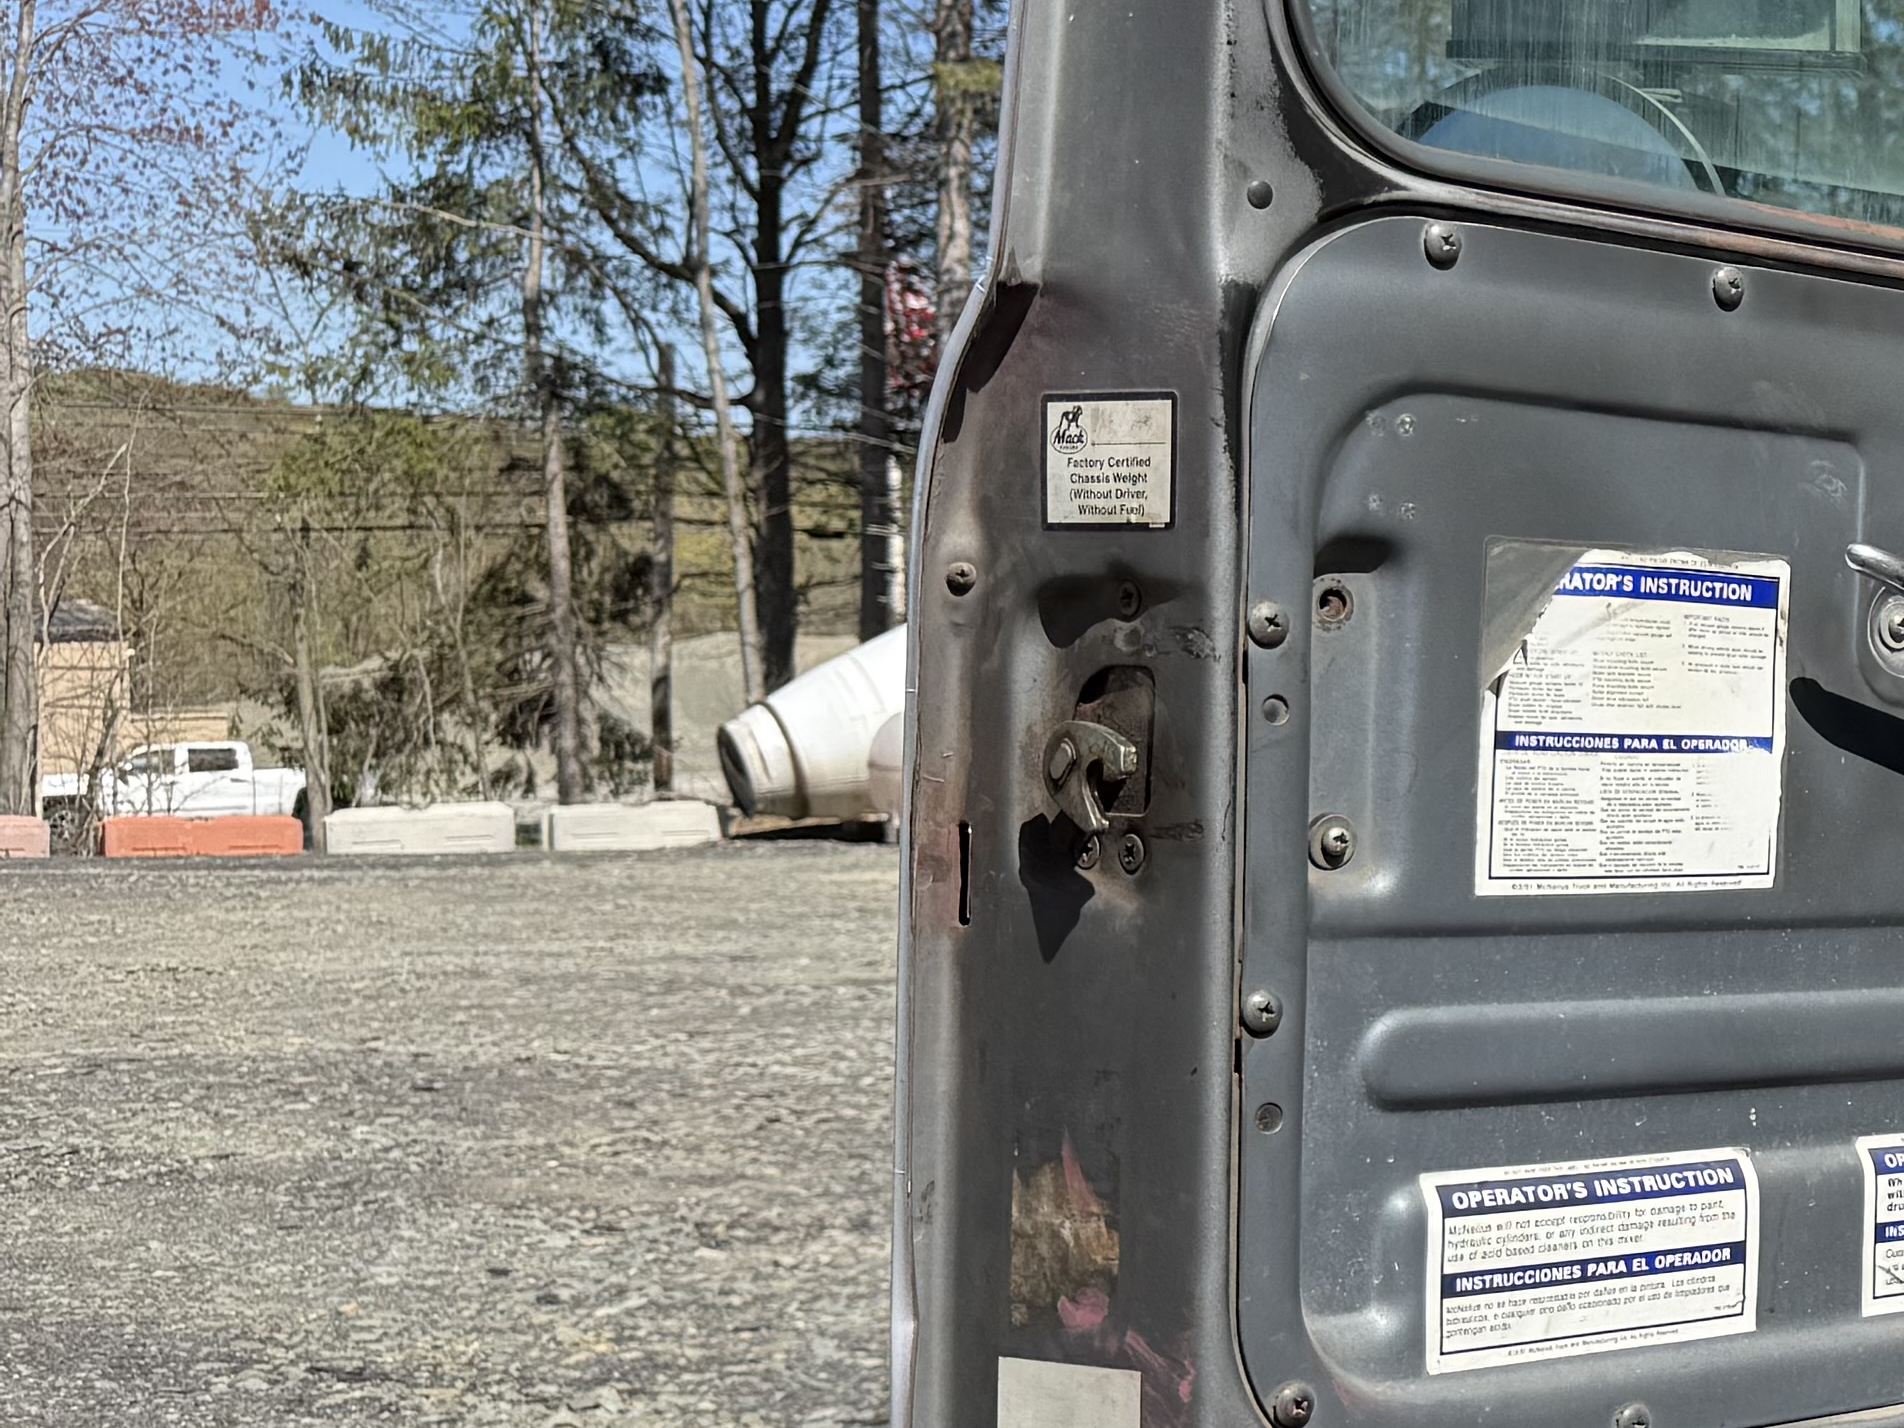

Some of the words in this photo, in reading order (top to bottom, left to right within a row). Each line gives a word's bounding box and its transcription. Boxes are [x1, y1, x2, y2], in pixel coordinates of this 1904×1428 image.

[1067, 458, 1104, 470] Factory
[1108, 457, 1151, 467] Certified
[1070, 473, 1110, 484] Chassis
[1113, 473, 1147, 486] Weight
[1070, 489, 1112, 501] (Without
[1115, 489, 1147, 500] Driver,
[1078, 505, 1116, 515] Without
[1120, 504, 1144, 517] Fuel)
[1555, 572, 1634, 593] RATOR'S
[1640, 577, 1753, 601] INSTRUCTION
[1514, 735, 1620, 749] INSTRUCCIONES
[1624, 738, 1659, 750] PARA
[1662, 739, 1677, 750] EL
[1451, 1180, 1587, 1210] OPERATOR'S
[1594, 1166, 1733, 1196] INSTRUCTION
[1455, 1264, 1581, 1292] INSTRUCCIONES
[1587, 1259, 1626, 1277] PARA
[1632, 1257, 1648, 1271] EL
[1654, 1247, 1731, 1269] OPERADOR
